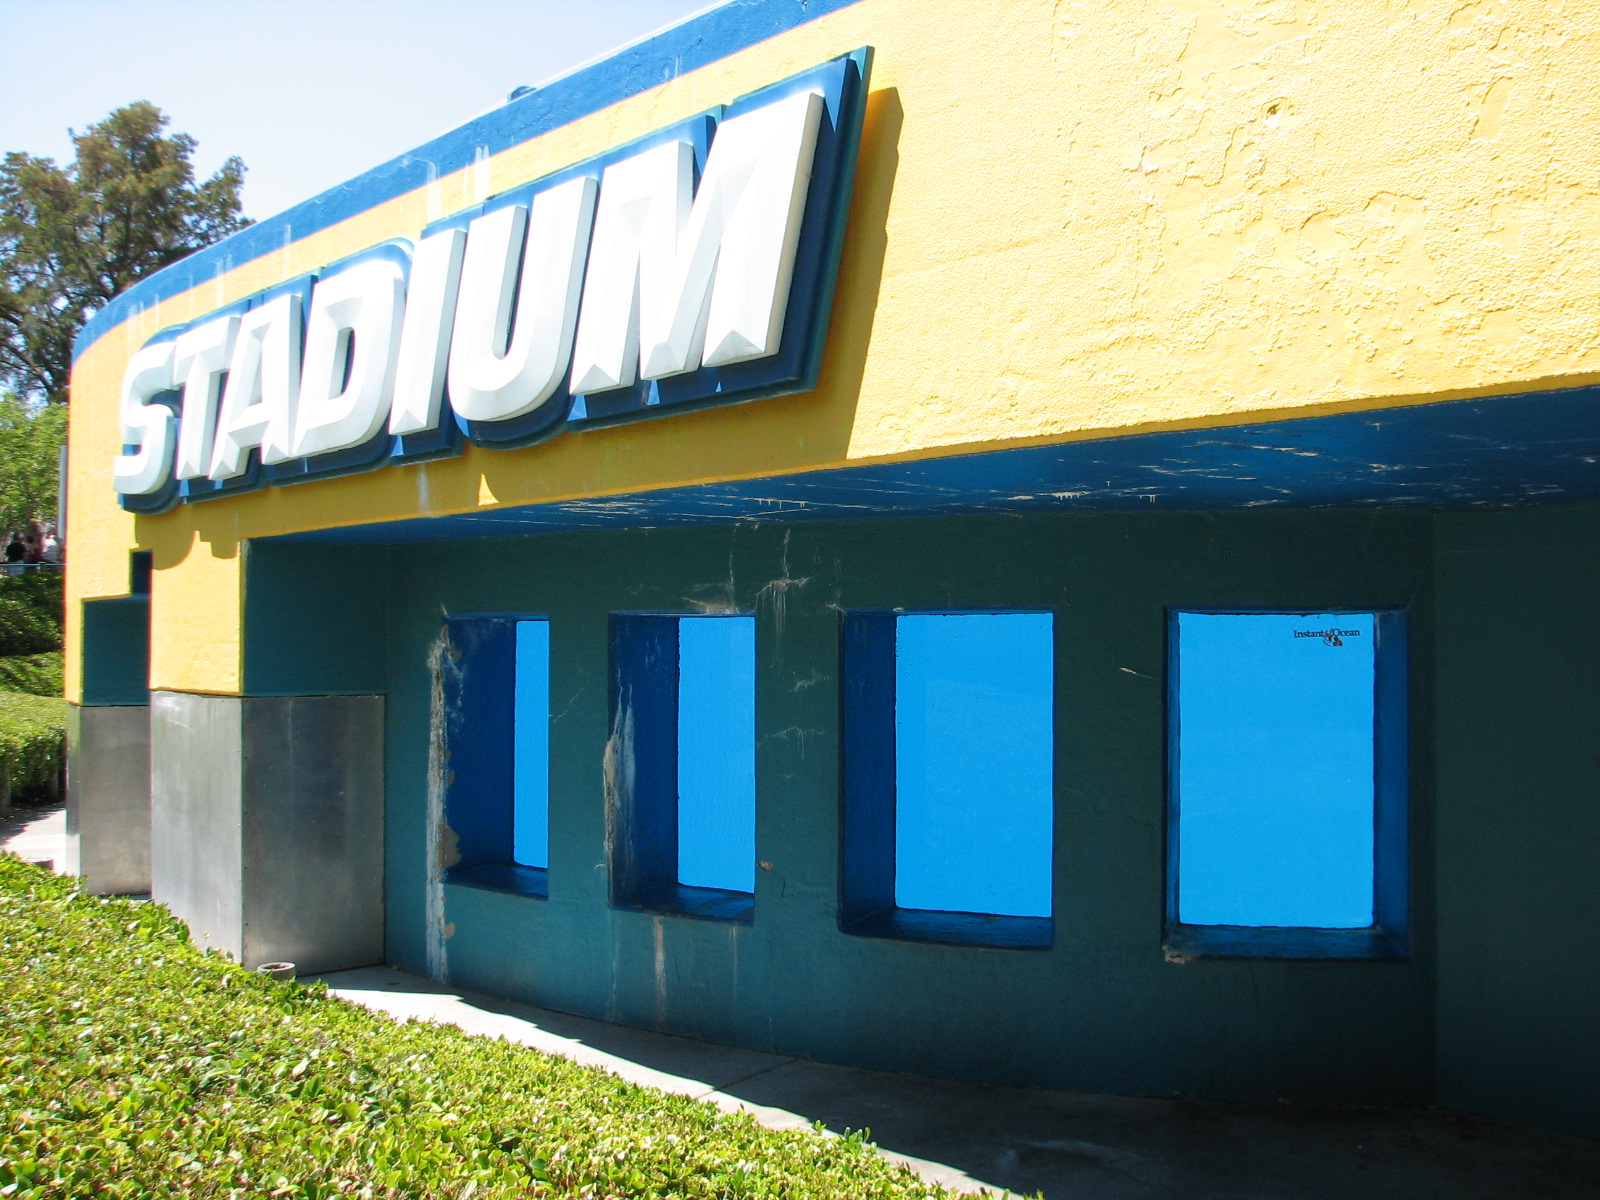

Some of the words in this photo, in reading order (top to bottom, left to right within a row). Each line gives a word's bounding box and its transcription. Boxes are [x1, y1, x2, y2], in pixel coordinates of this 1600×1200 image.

[113, 90, 826, 496] STADIUM
[1293, 629, 1326, 638] Instant
[1332, 628, 1360, 637] Ocean
